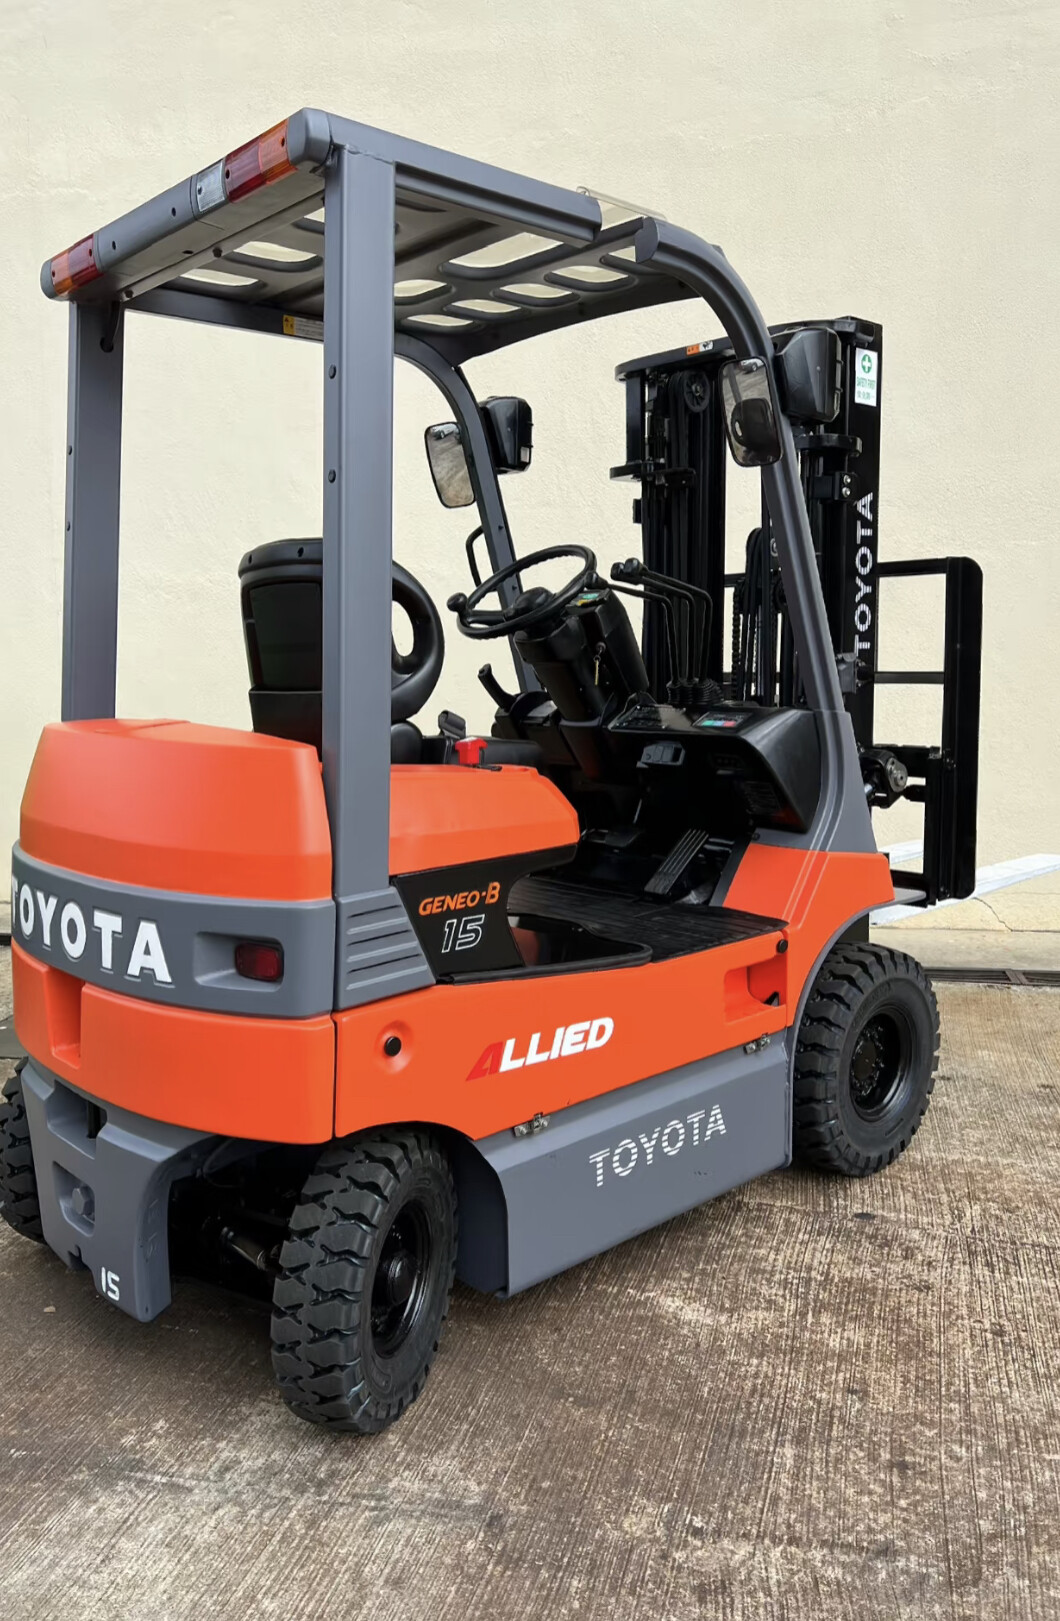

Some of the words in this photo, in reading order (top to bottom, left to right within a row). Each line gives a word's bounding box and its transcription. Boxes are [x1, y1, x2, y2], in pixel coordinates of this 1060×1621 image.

[854, 492, 874, 657] TOYOTA
[418, 881, 501, 916] GENEO-B
[441, 913, 486, 954] 15
[465, 1017, 615, 1082] ALLIED
[588, 1104, 727, 1188] TOYOTA
[101, 1266, 120, 1301] 15
